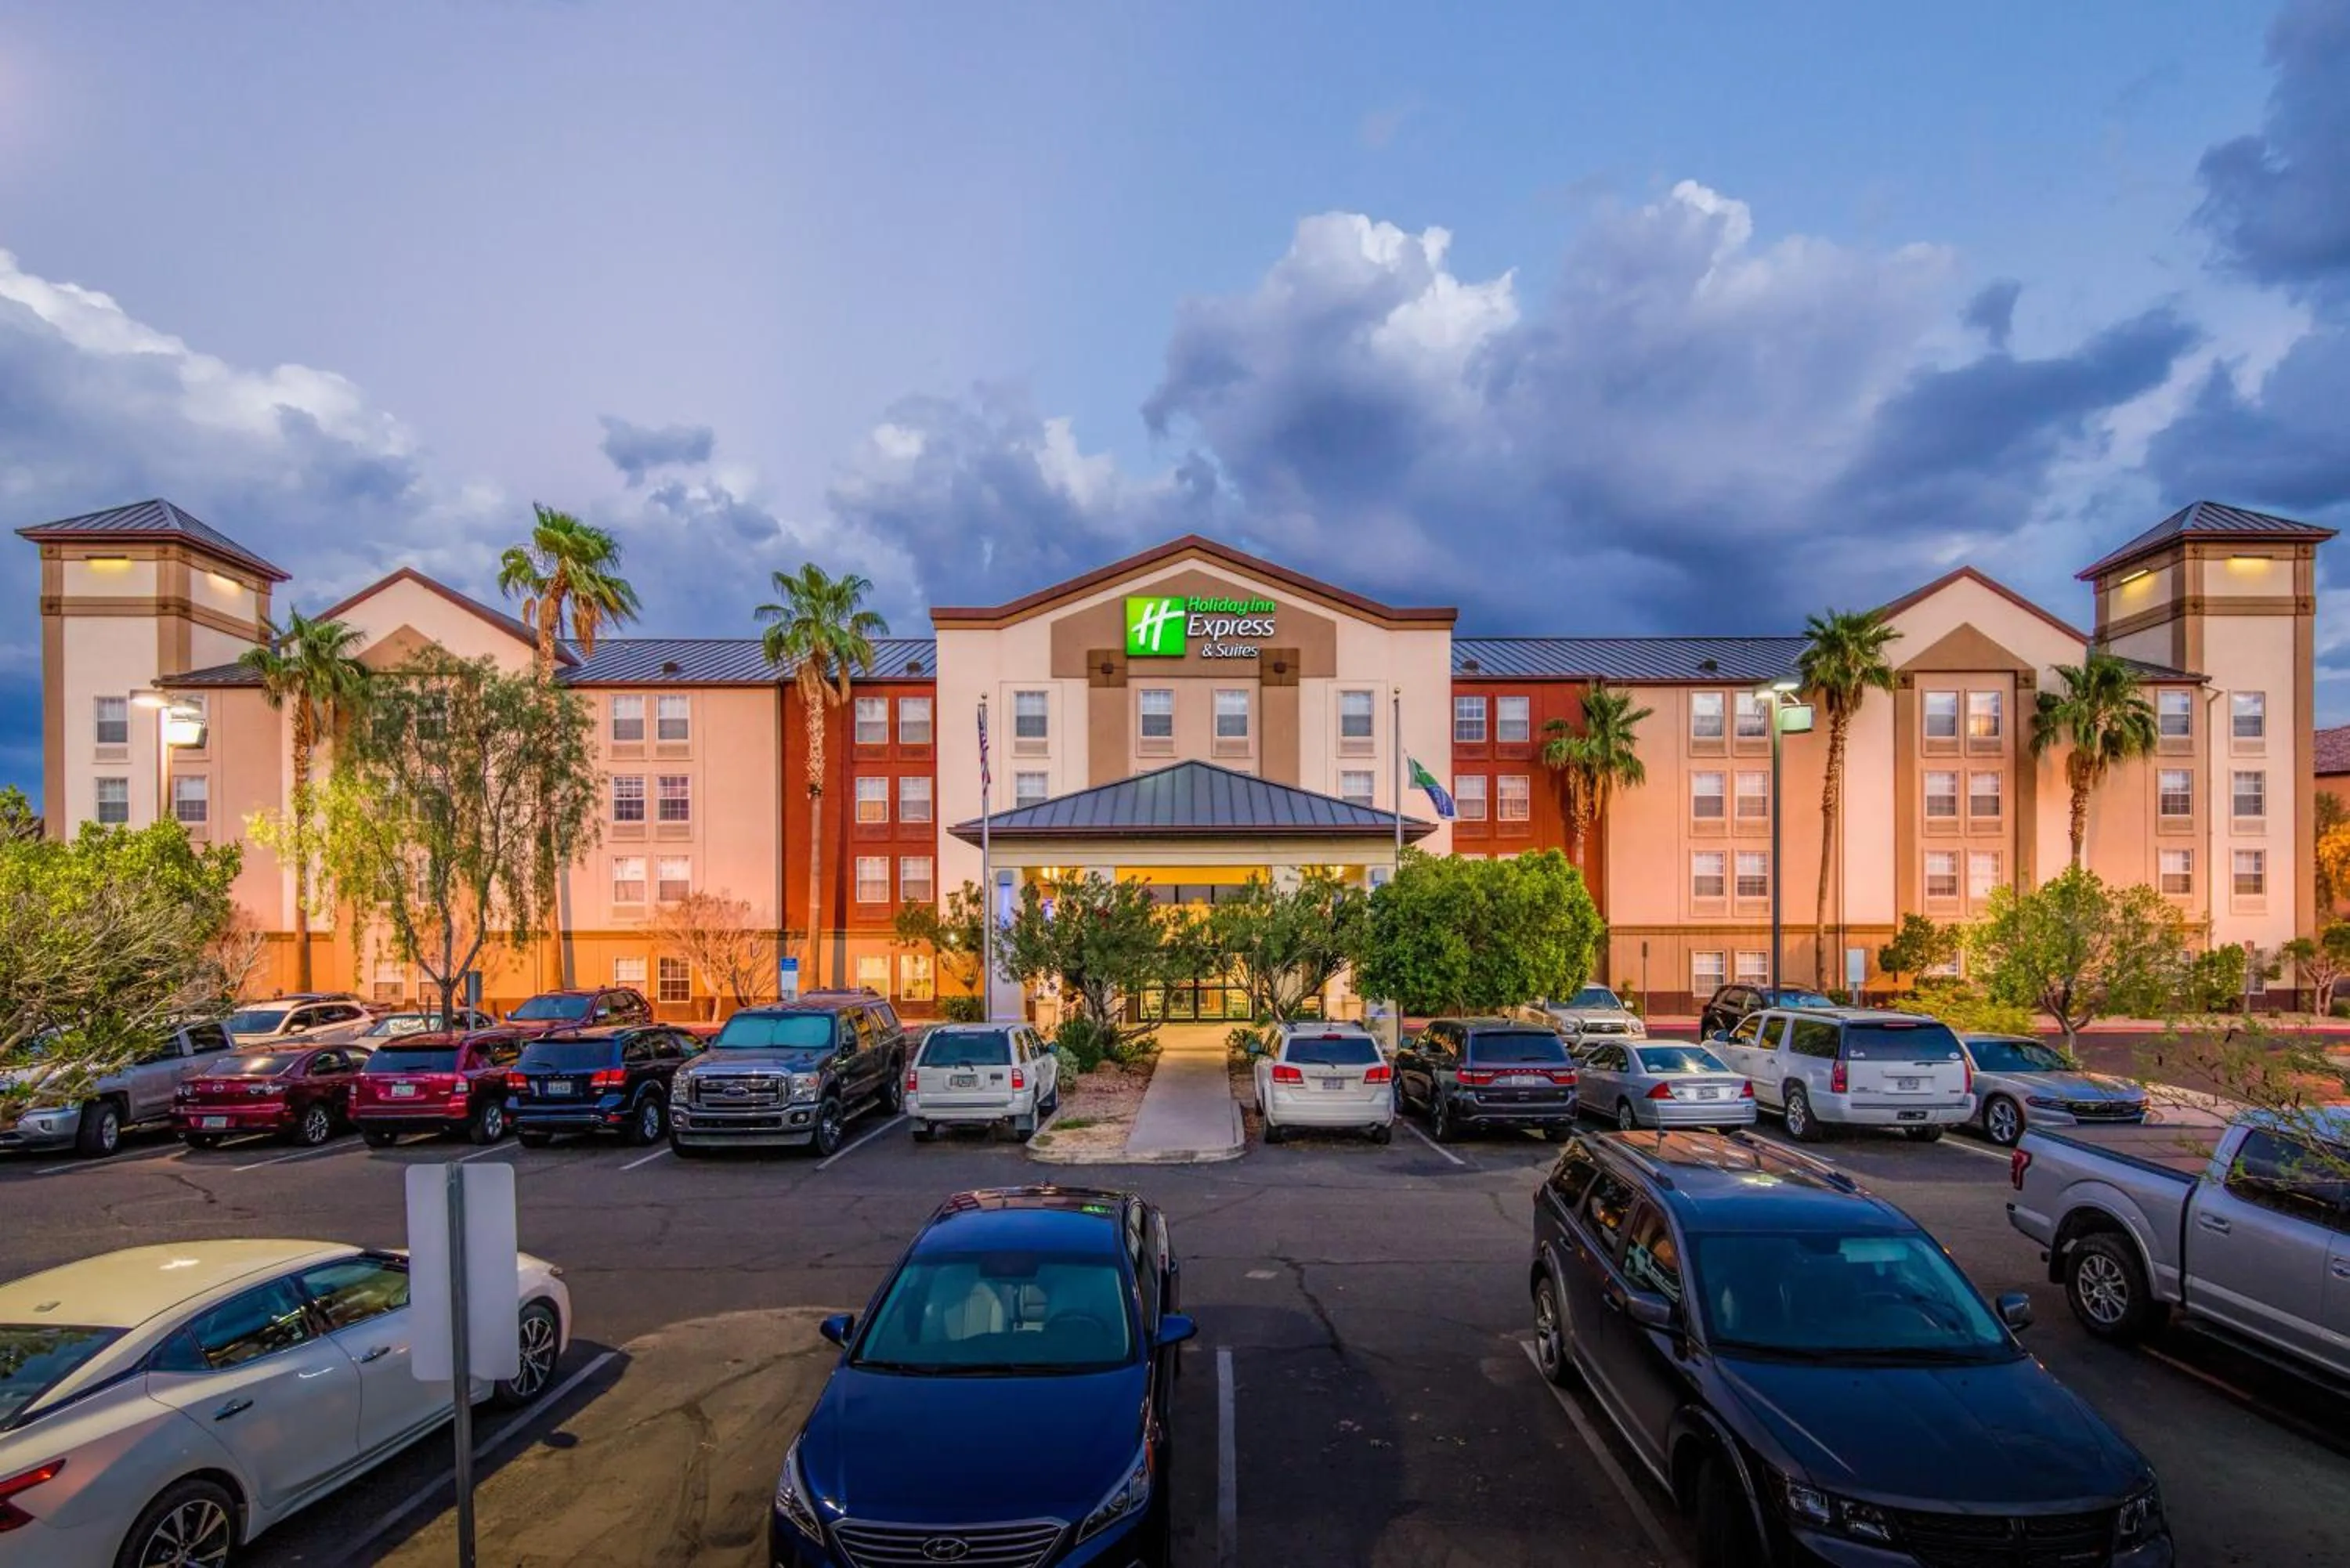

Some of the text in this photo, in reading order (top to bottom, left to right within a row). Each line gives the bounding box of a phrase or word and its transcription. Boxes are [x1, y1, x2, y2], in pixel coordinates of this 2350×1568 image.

[1187, 596, 1276, 615] Holiday Inn
[1131, 599, 1185, 652] H
[1187, 614, 1276, 641] Express
[1202, 642, 1258, 657] & Suites
